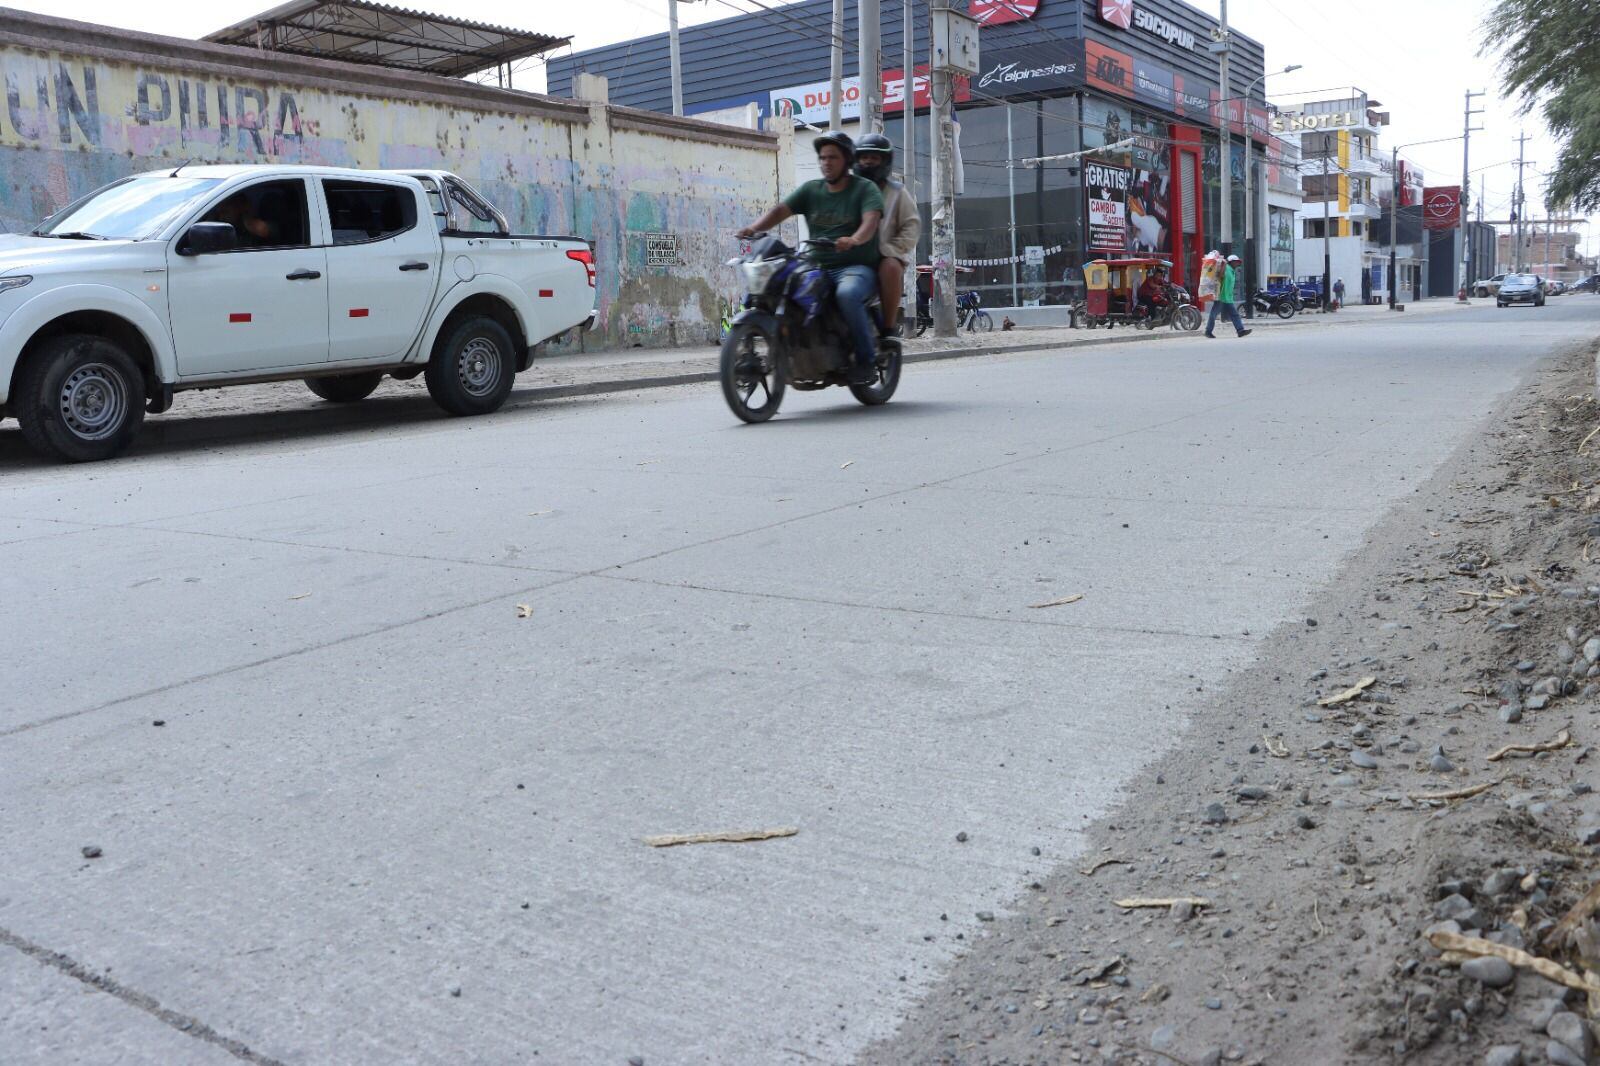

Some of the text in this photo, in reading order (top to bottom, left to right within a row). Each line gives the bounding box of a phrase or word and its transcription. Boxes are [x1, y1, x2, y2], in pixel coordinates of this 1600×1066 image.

[1135, 8, 1195, 51] SOCOPUR
[0, 63, 101, 145] UN
[1290, 112, 1355, 131] HOTEL
